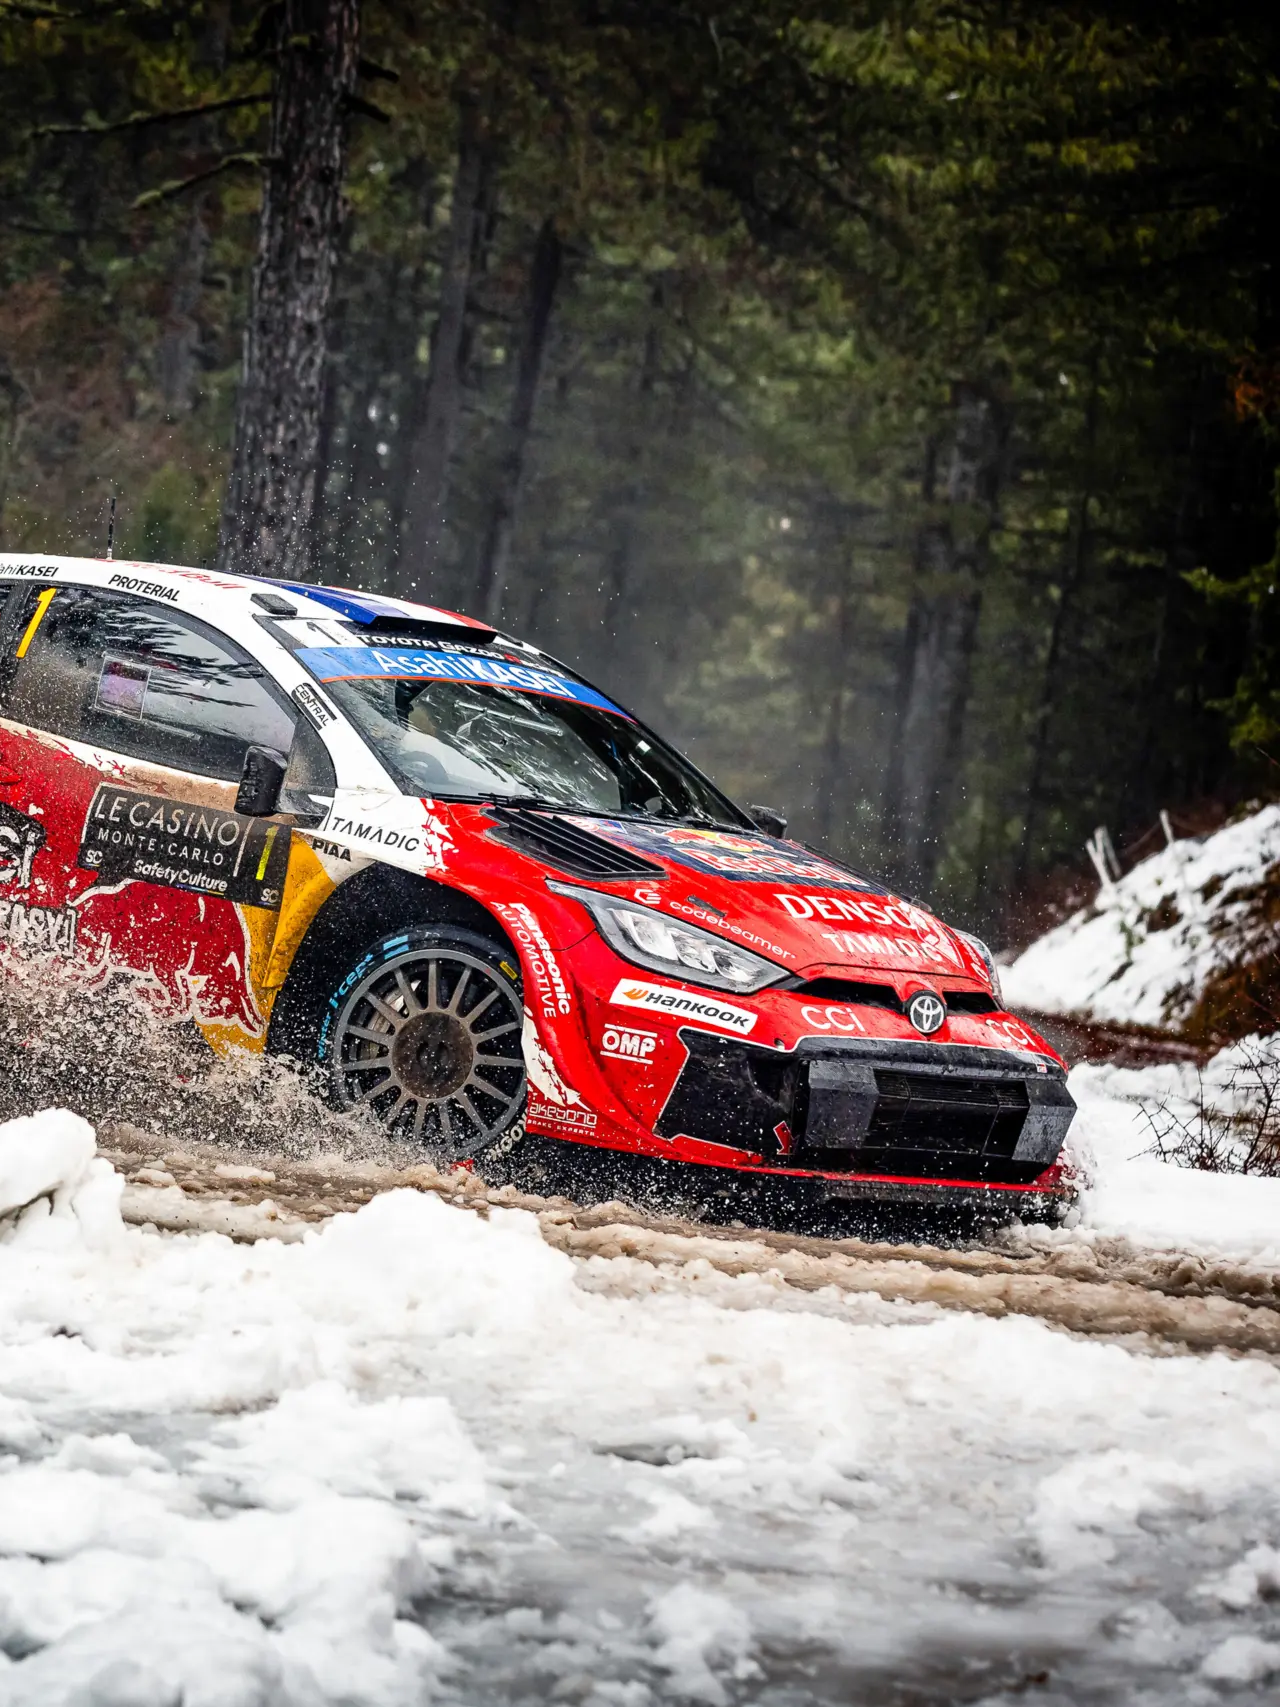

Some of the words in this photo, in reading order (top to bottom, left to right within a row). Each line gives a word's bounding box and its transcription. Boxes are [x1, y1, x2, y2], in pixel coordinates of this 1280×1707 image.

[108, 574, 180, 602] PROTERIAL
[16, 587, 57, 658] 1
[306, 621, 342, 645] 1
[356, 634, 438, 648] TOYOTA
[438, 641, 505, 659] GAZOO
[295, 684, 329, 727] CENTRAL
[94, 793, 127, 822] LE
[129, 802, 240, 846] CASINO
[332, 817, 420, 852] TAMADIC
[85, 850, 103, 864] SC
[255, 825, 279, 881] 1
[311, 838, 352, 862] PIAA
[260, 888, 280, 904] SC
[773, 894, 929, 931] DENSO
[670, 901, 792, 959] codebeamer
[490, 901, 556, 1018] AUTOMOTIVE
[508, 902, 572, 1015] Panasonic
[821, 933, 943, 962] TAMADIC
[602, 1030, 657, 1058] OMP
[527, 1119, 552, 1129] BRAKE
